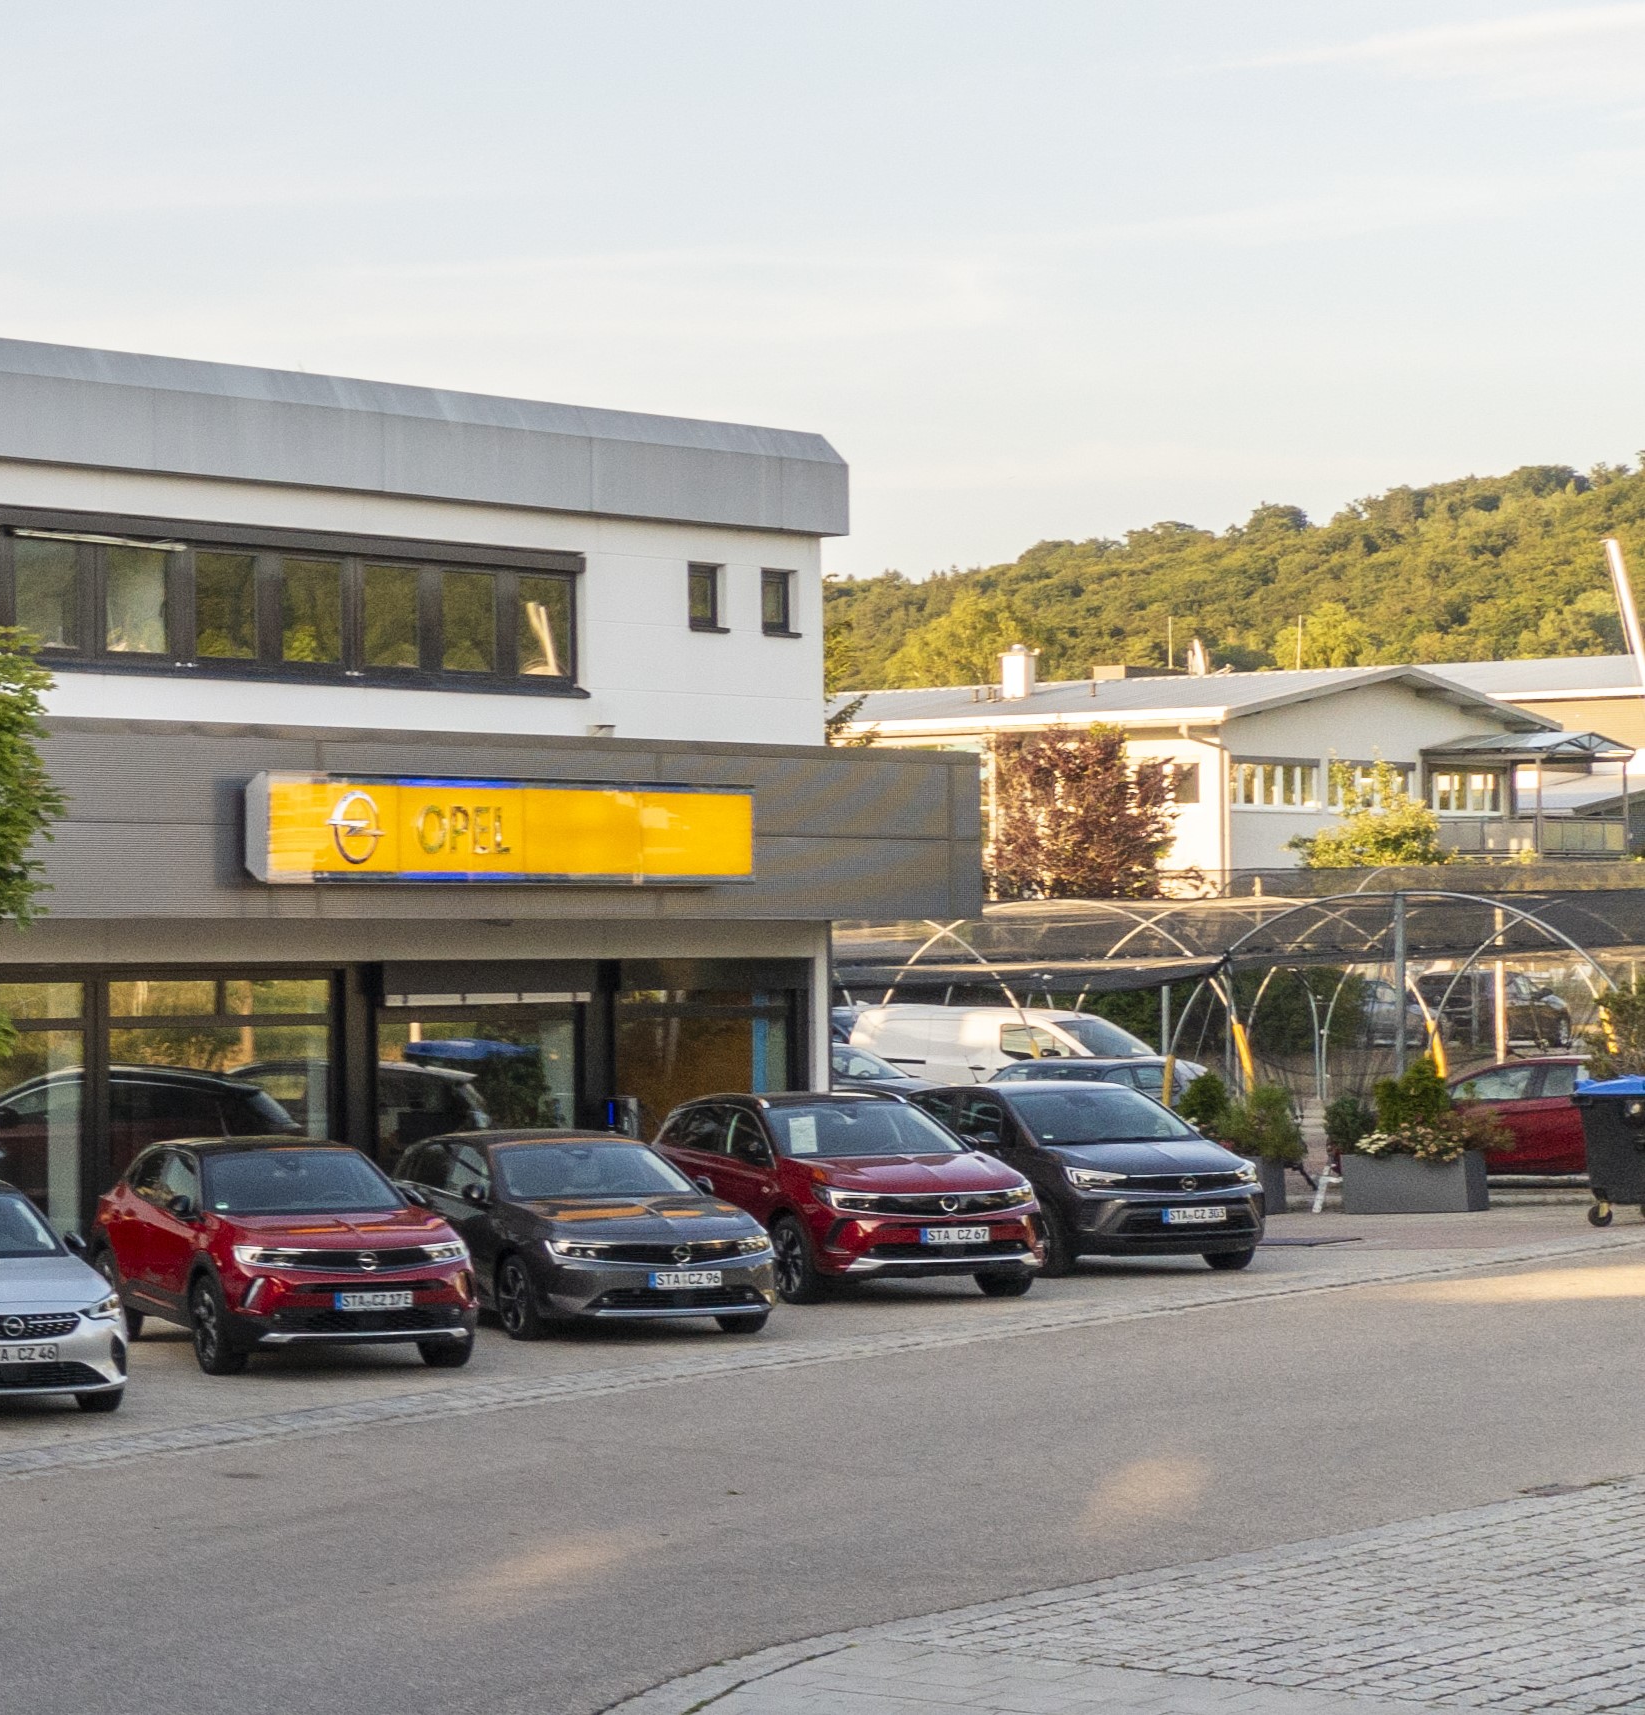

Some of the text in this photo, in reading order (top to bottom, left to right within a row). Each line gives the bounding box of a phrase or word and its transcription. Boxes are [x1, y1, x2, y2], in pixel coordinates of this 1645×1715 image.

[417, 805, 511, 855] OPEL
[1169, 1209, 1188, 1221] STA
[928, 1228, 988, 1241] STA CZ 67
[656, 1273, 721, 1286] STA CZ 96
[18, 1347, 36, 1361] CZ
[38, 1346, 56, 1360] 46
